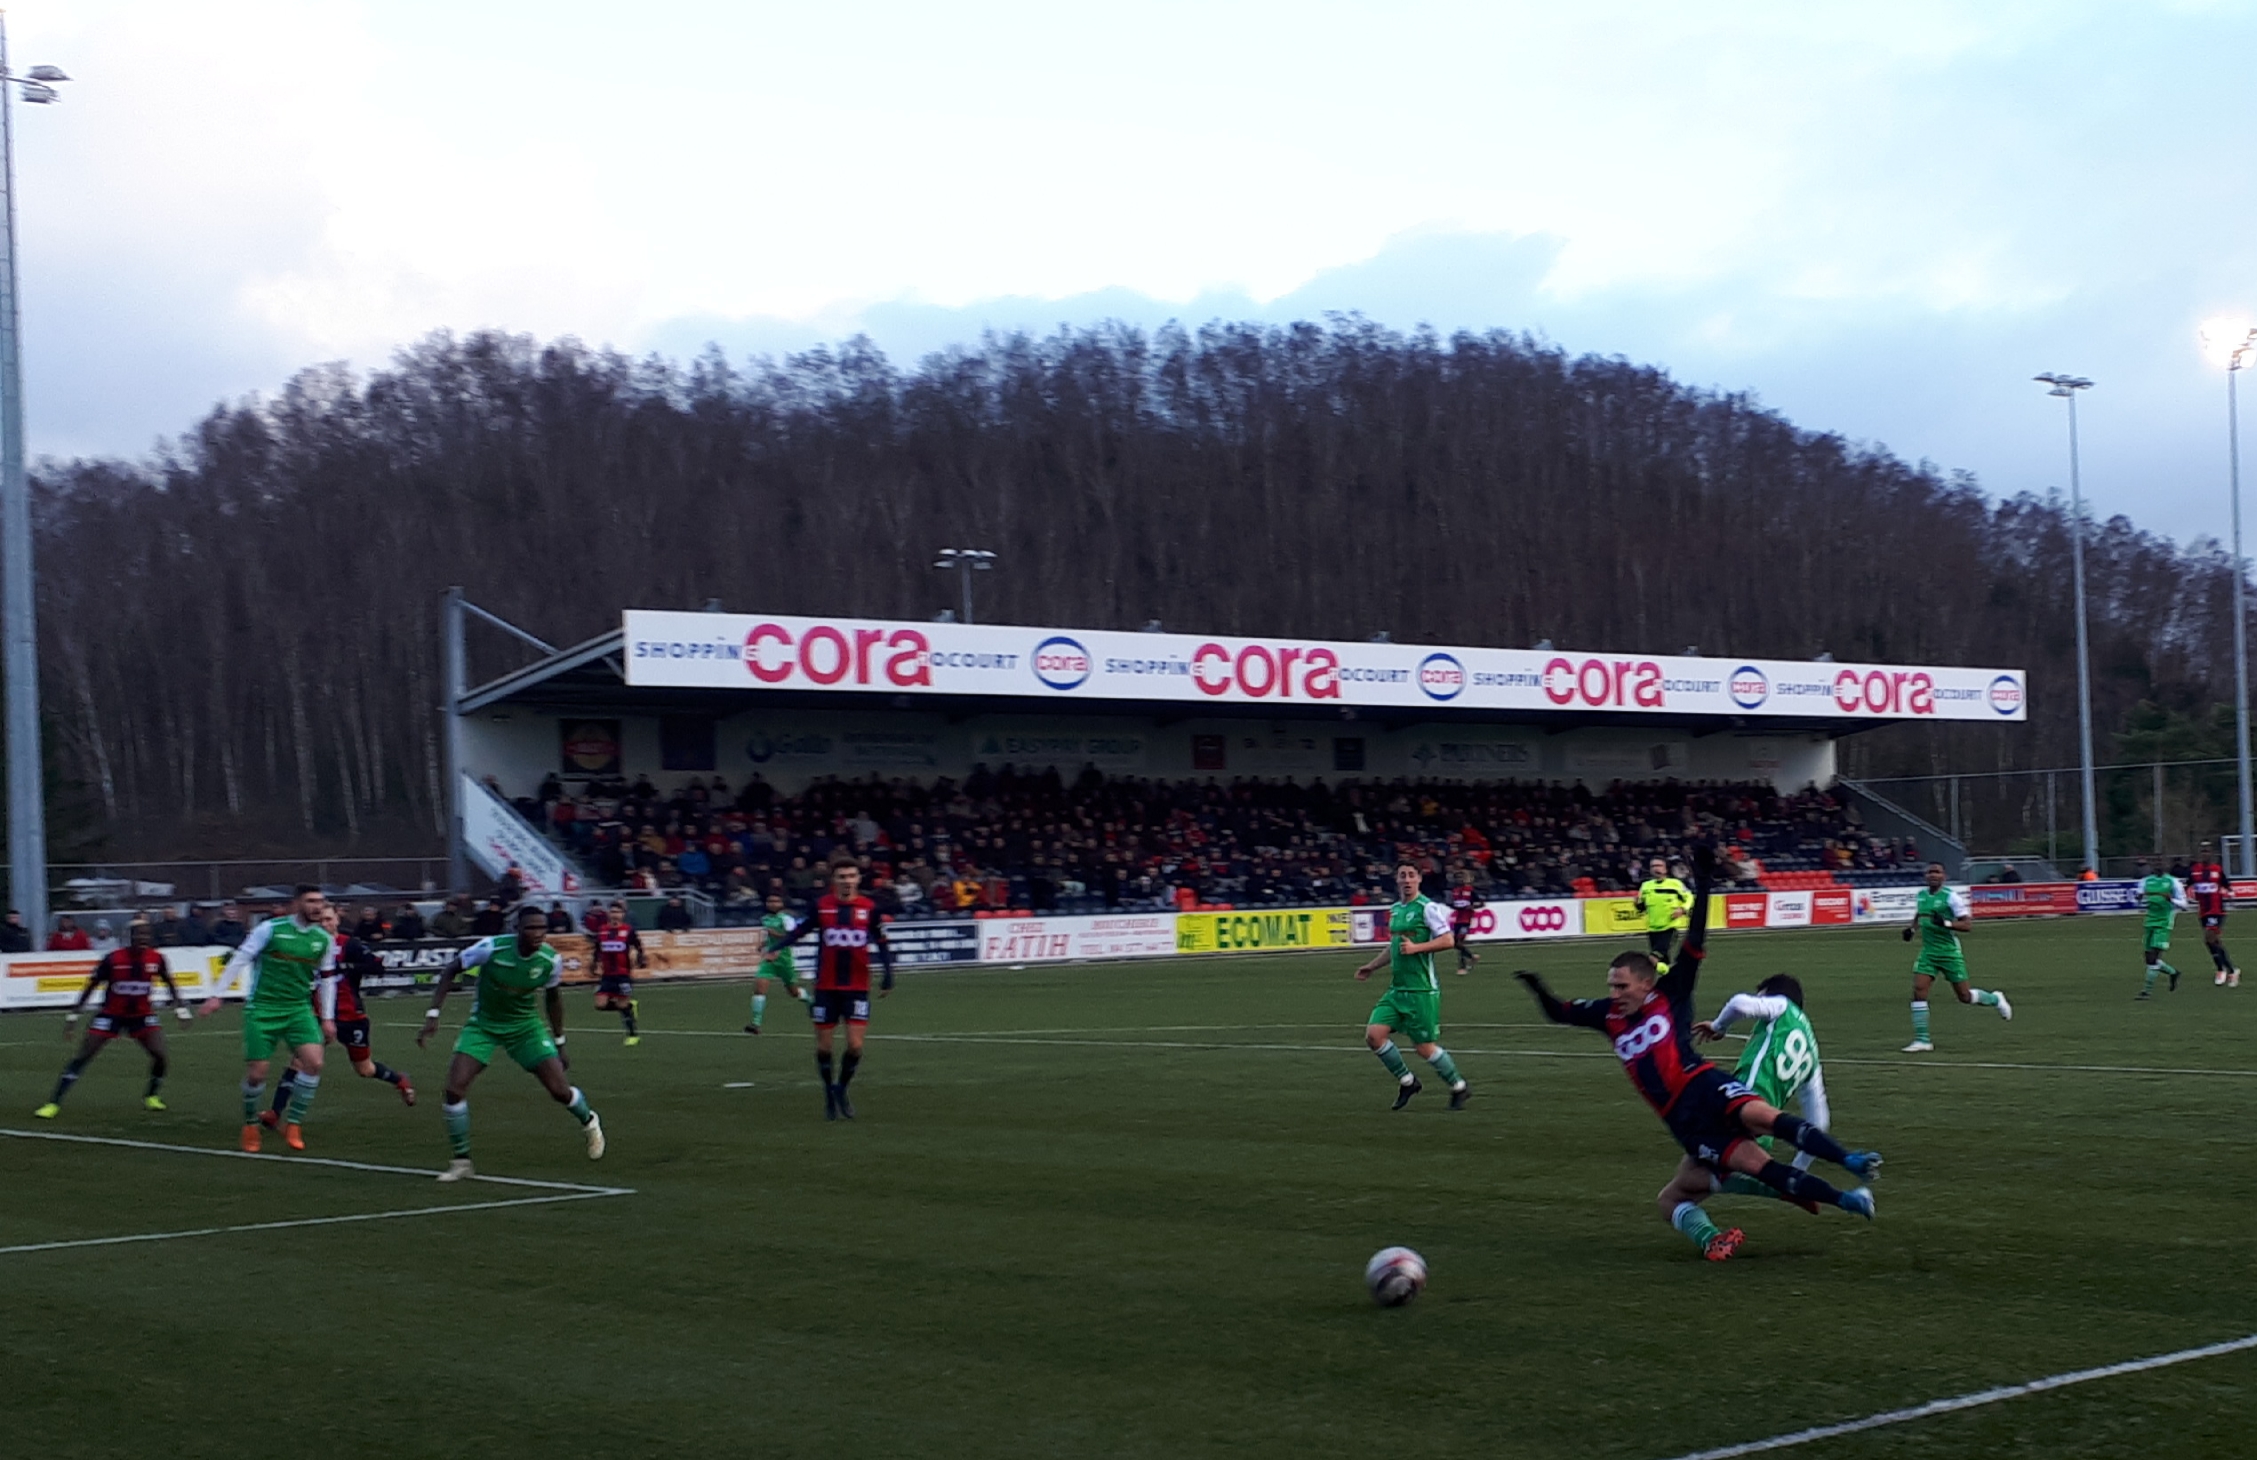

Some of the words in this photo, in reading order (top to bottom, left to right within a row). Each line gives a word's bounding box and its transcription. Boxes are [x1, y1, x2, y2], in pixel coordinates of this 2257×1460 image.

[745, 623, 933, 688] cora
[1035, 654, 1089, 672] cora
[1192, 643, 1341, 699] cora
[1420, 669, 1464, 685] cora
[1543, 657, 1664, 707] cora
[1835, 669, 1936, 715] cora
[984, 934, 1071, 960] FATIH
